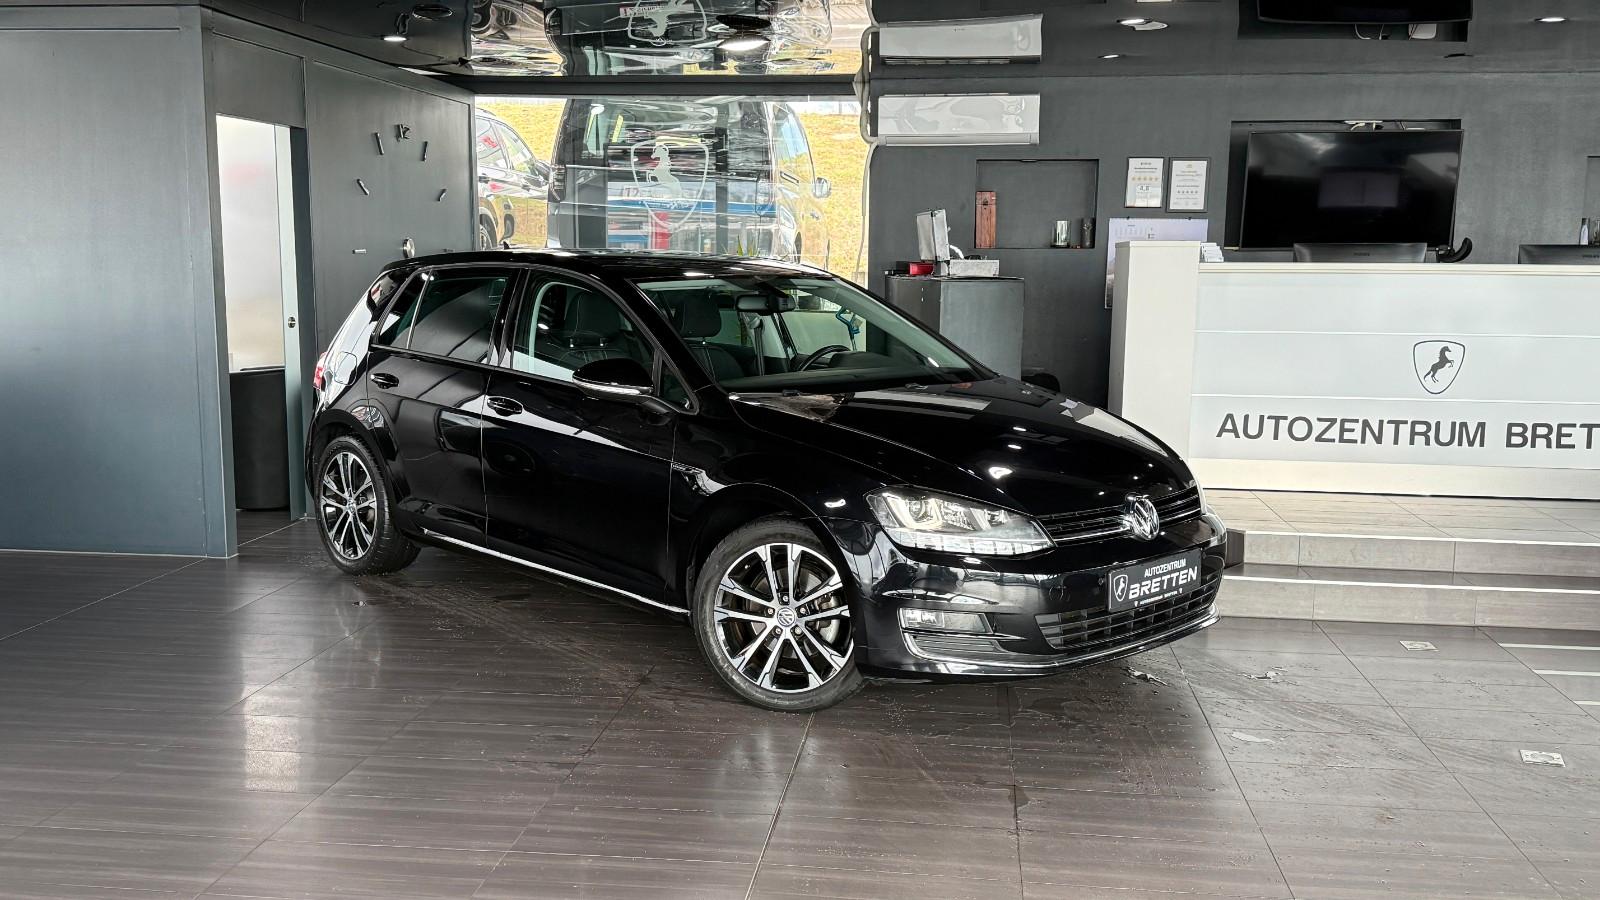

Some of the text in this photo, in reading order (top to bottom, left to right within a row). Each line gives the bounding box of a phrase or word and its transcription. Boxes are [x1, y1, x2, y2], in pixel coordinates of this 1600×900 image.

[1216, 413, 1600, 449] AUTOZENTRUM BRET
[1128, 566, 1198, 600] BRETTEN
[1144, 558, 1187, 578] AUTOZENTRUM
